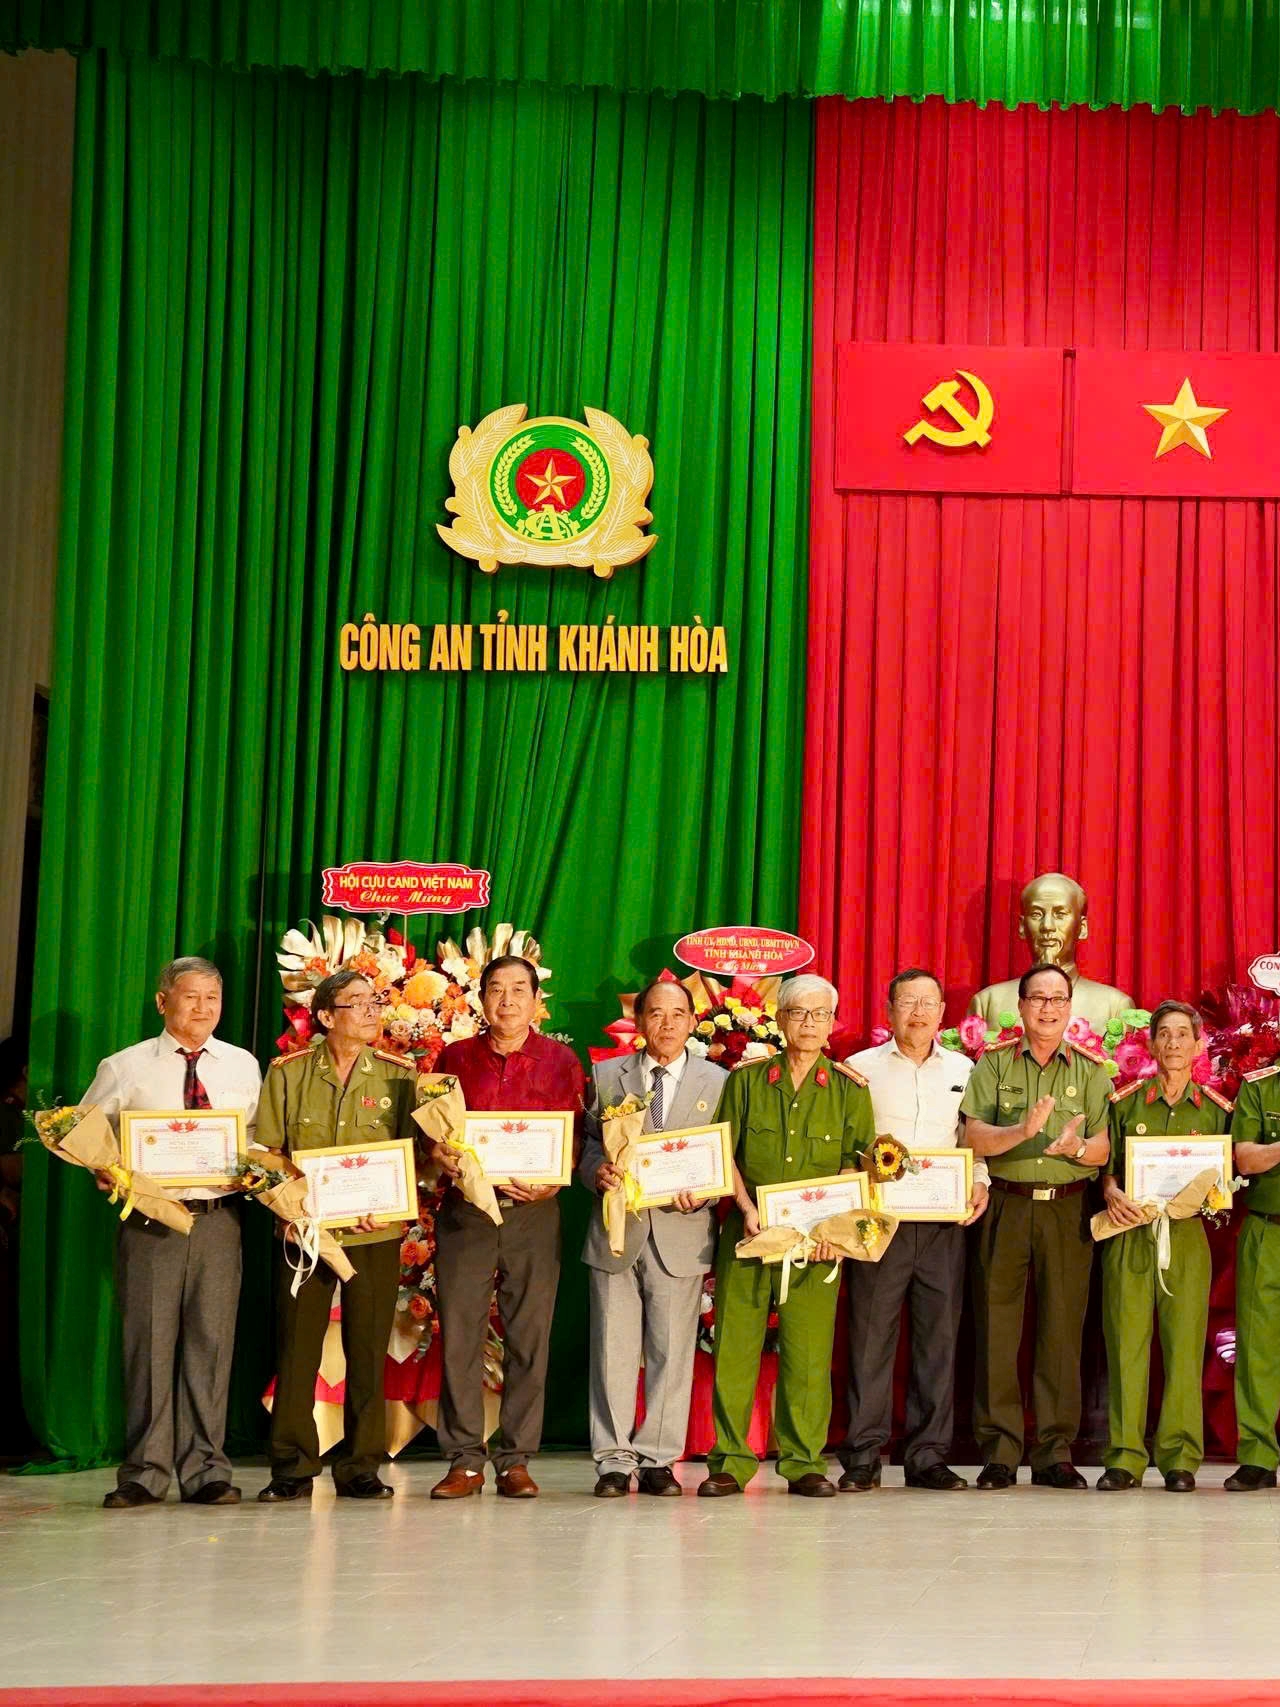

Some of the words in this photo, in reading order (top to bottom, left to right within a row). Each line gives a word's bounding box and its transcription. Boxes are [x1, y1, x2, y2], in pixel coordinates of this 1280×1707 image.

[340, 612, 421, 671] CÔNG
[429, 623, 473, 671] AN
[479, 609, 547, 671] TỈNH
[559, 614, 660, 672] KHÁNH
[670, 614, 729, 673] HÒA
[339, 875, 360, 891] HỘI
[361, 876, 385, 892] CỰU
[387, 876, 419, 889] CAND
[420, 874, 446, 891] VIỆT
[447, 877, 473, 890] NAM
[359, 890, 399, 903] Chúc
